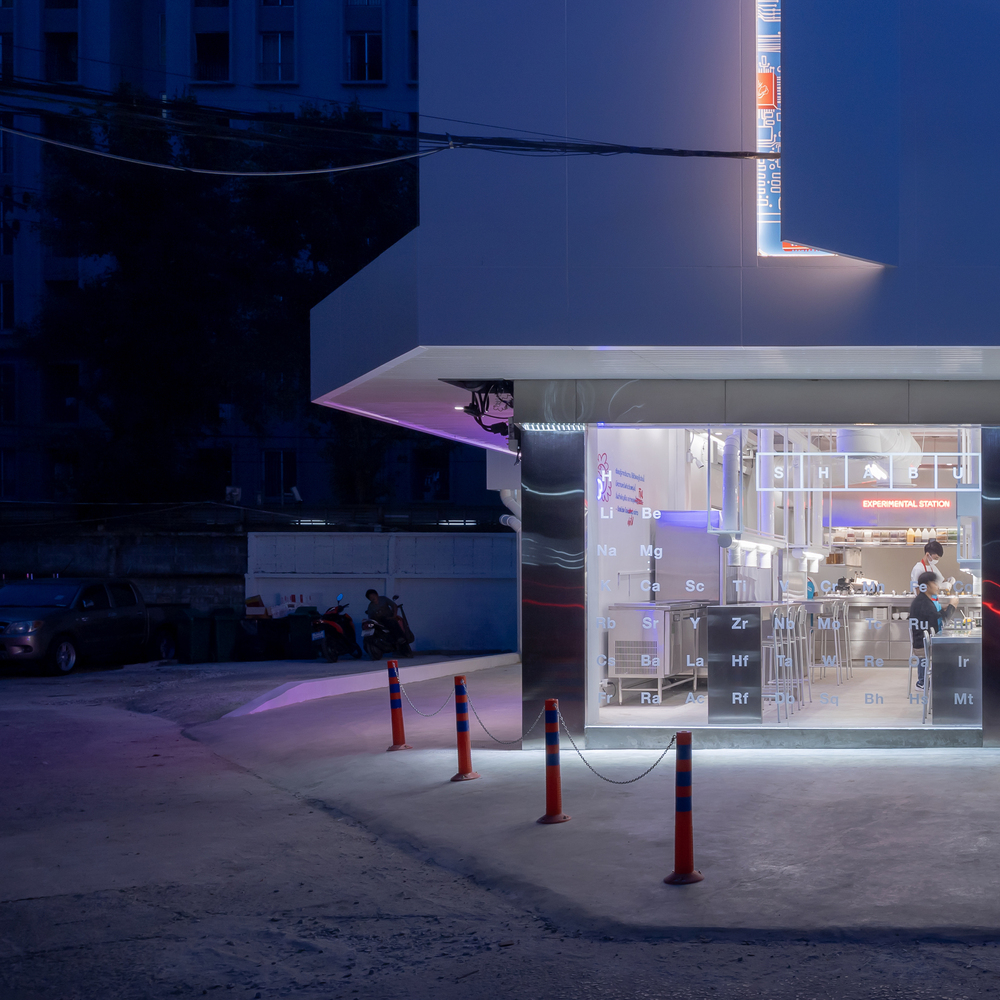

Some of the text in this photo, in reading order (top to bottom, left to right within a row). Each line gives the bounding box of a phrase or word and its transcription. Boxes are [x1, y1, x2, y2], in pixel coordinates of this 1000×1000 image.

[602, 470, 612, 482] H
[600, 507, 614, 519] Li
[642, 507, 662, 519] Be
[597, 545, 616, 556] Na
[640, 545, 663, 560] Mg
[600, 580, 612, 592] K
[640, 580, 660, 592] Ca
[685, 580, 705, 592] Sc
[732, 580, 746, 592] Ti
[780, 580, 790, 592] V
[820, 580, 838, 592] Cr
[596, 617, 616, 630] Rb
[642, 617, 659, 630] Sr
[690, 618, 700, 630] Y
[732, 618, 748, 630] Zr
[774, 618, 795, 630] Nb
[818, 618, 841, 630] Mo
[865, 618, 882, 630] Tc
[910, 618, 928, 630] Ru
[596, 655, 616, 667] Cs
[641, 655, 660, 667] Ba
[686, 655, 704, 667] La
[732, 655, 748, 667] Hf
[776, 655, 792, 667] Ta
[822, 655, 837, 667] W
[864, 656, 884, 667] Re
[958, 656, 969, 667] Ir
[598, 692, 612, 704] Fr
[641, 692, 660, 704] Ra
[685, 692, 704, 704] Ac
[732, 692, 748, 704] Rf
[864, 694, 884, 704] Bh
[910, 694, 928, 704] Hs
[954, 694, 974, 704] Mt
